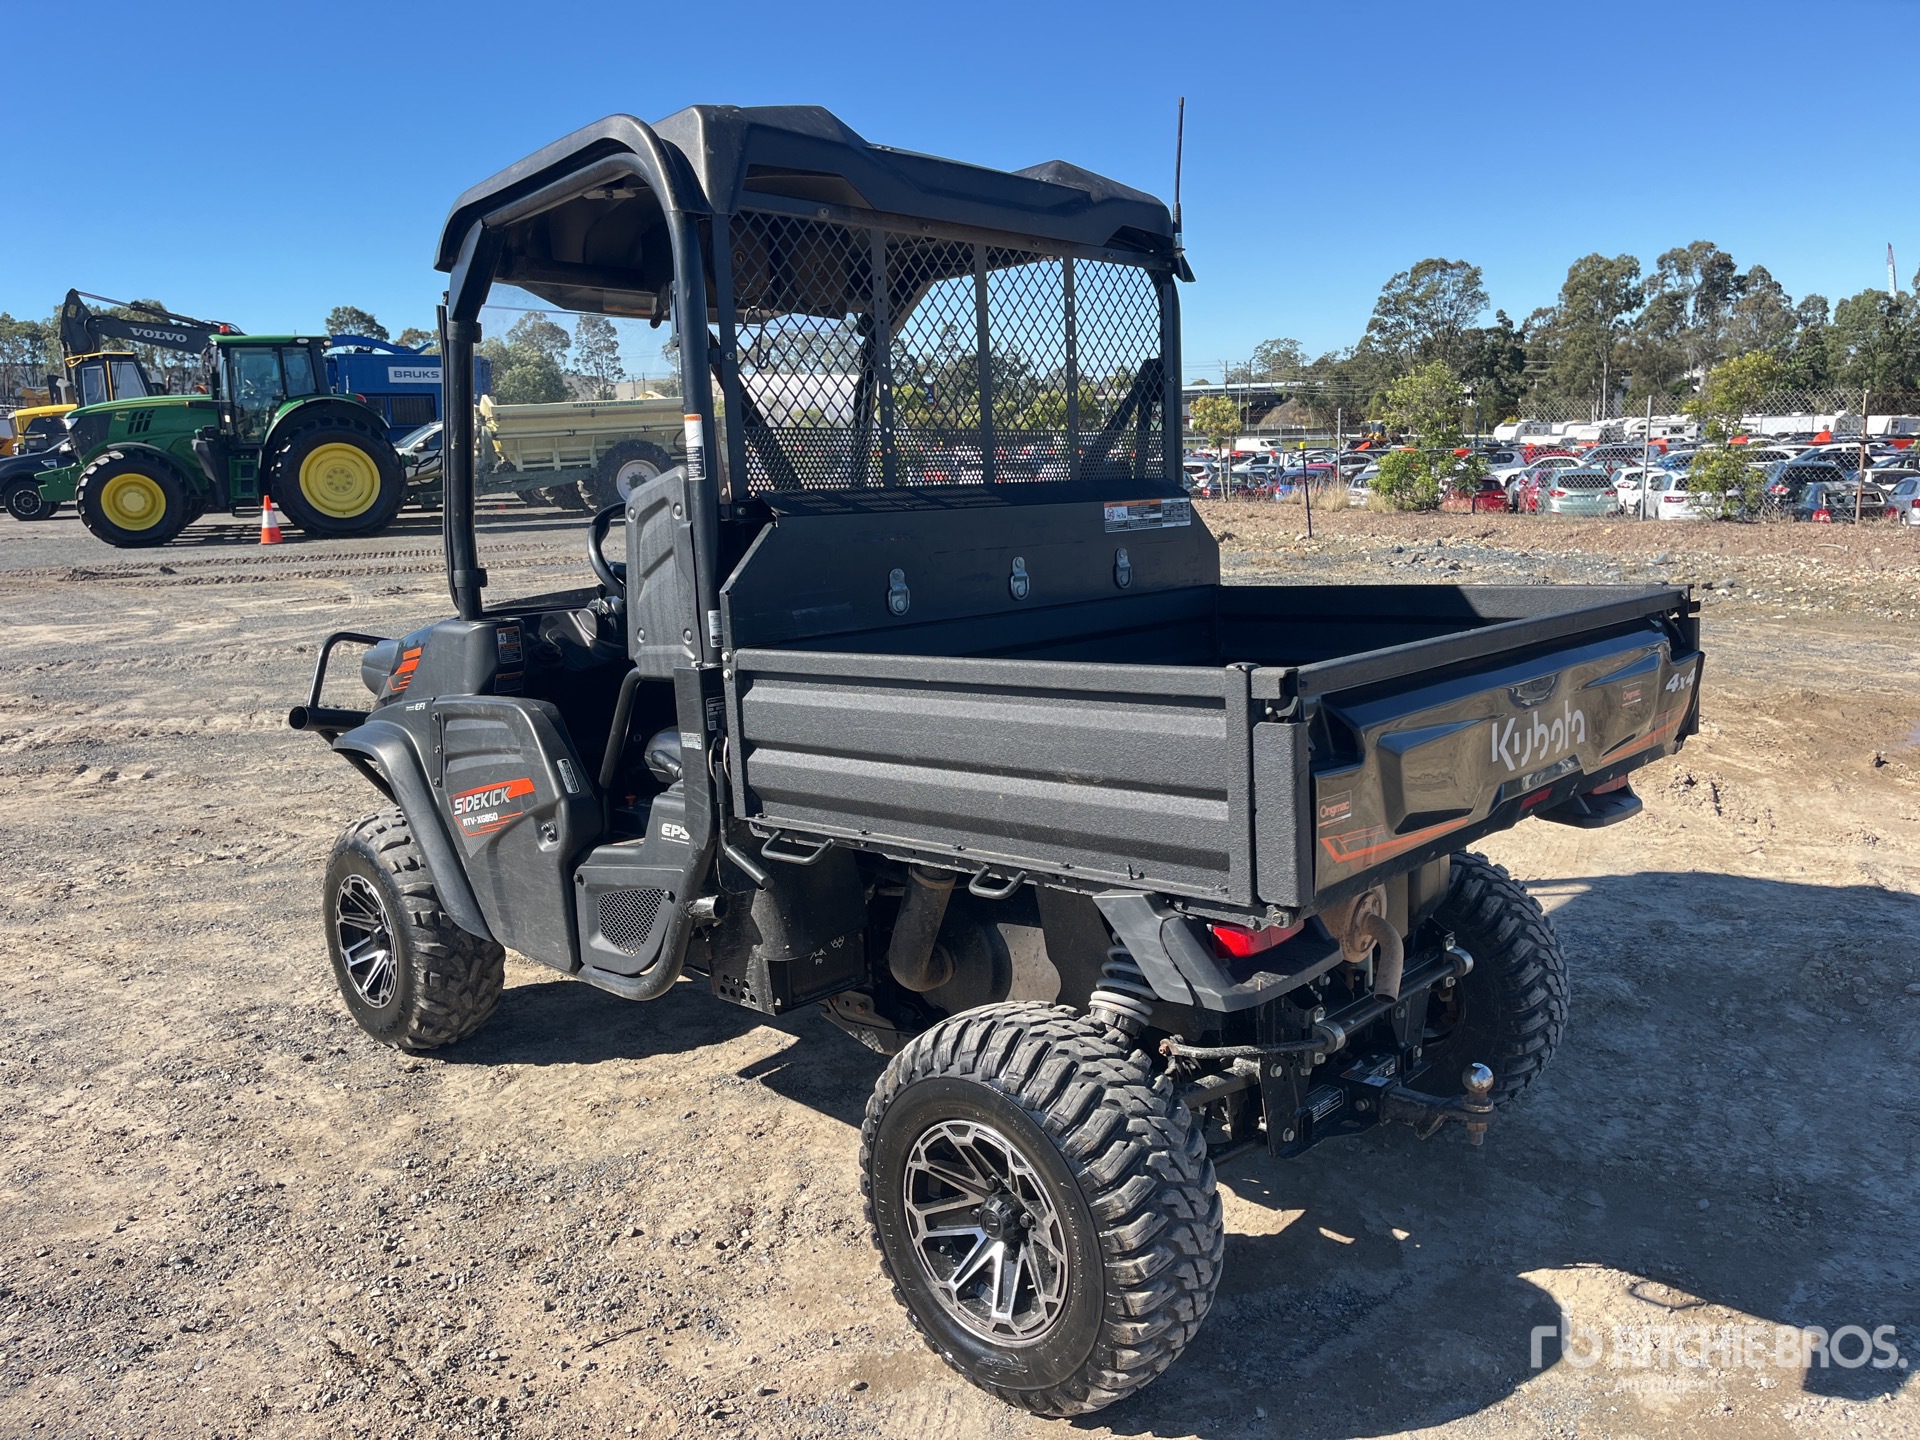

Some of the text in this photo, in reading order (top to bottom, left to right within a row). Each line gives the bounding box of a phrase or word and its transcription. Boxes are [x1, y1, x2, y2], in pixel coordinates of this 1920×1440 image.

[129, 327, 188, 343] VOLVO
[393, 370, 440, 379] BRUKS
[1665, 667, 1697, 693] 4x4
[1492, 700, 1585, 772] Kubota
[454, 785, 511, 816] SIDEKICK
[462, 812, 499, 827] RTV-XG850
[661, 823, 691, 840] EPS
